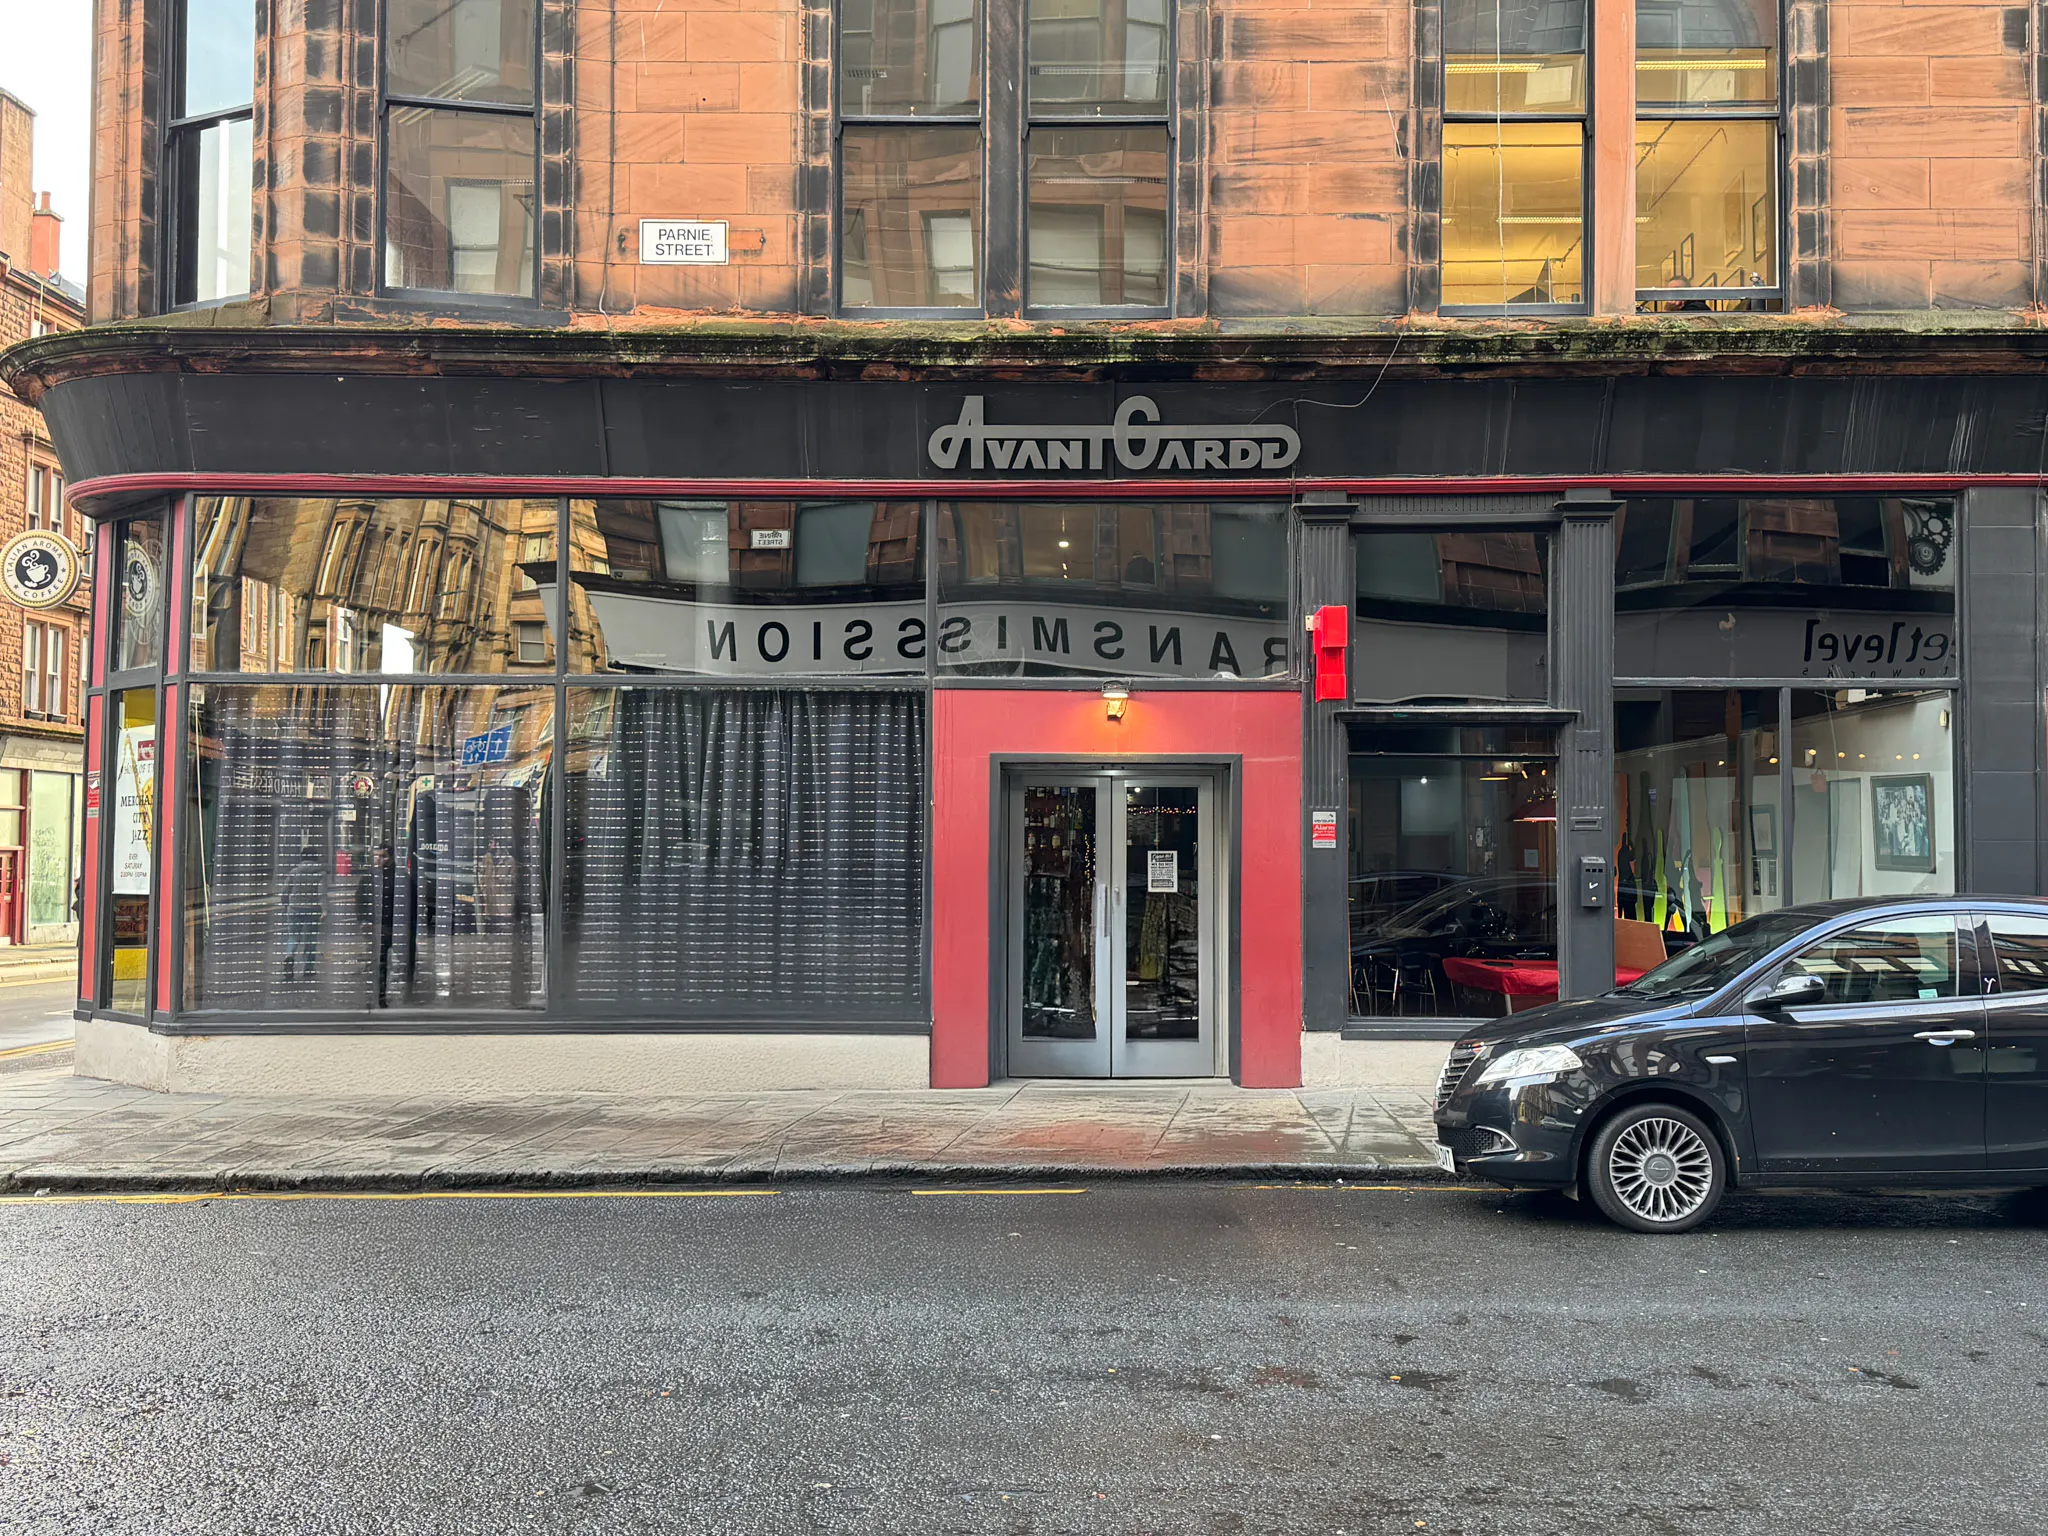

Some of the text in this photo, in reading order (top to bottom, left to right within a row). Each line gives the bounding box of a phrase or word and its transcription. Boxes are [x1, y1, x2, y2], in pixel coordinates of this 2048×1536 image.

[658, 229, 711, 241] PARNIE
[655, 243, 712, 256] STREET
[7, 540, 63, 577] ITALIAN AROMA
[23, 579, 64, 599] COFFEE
